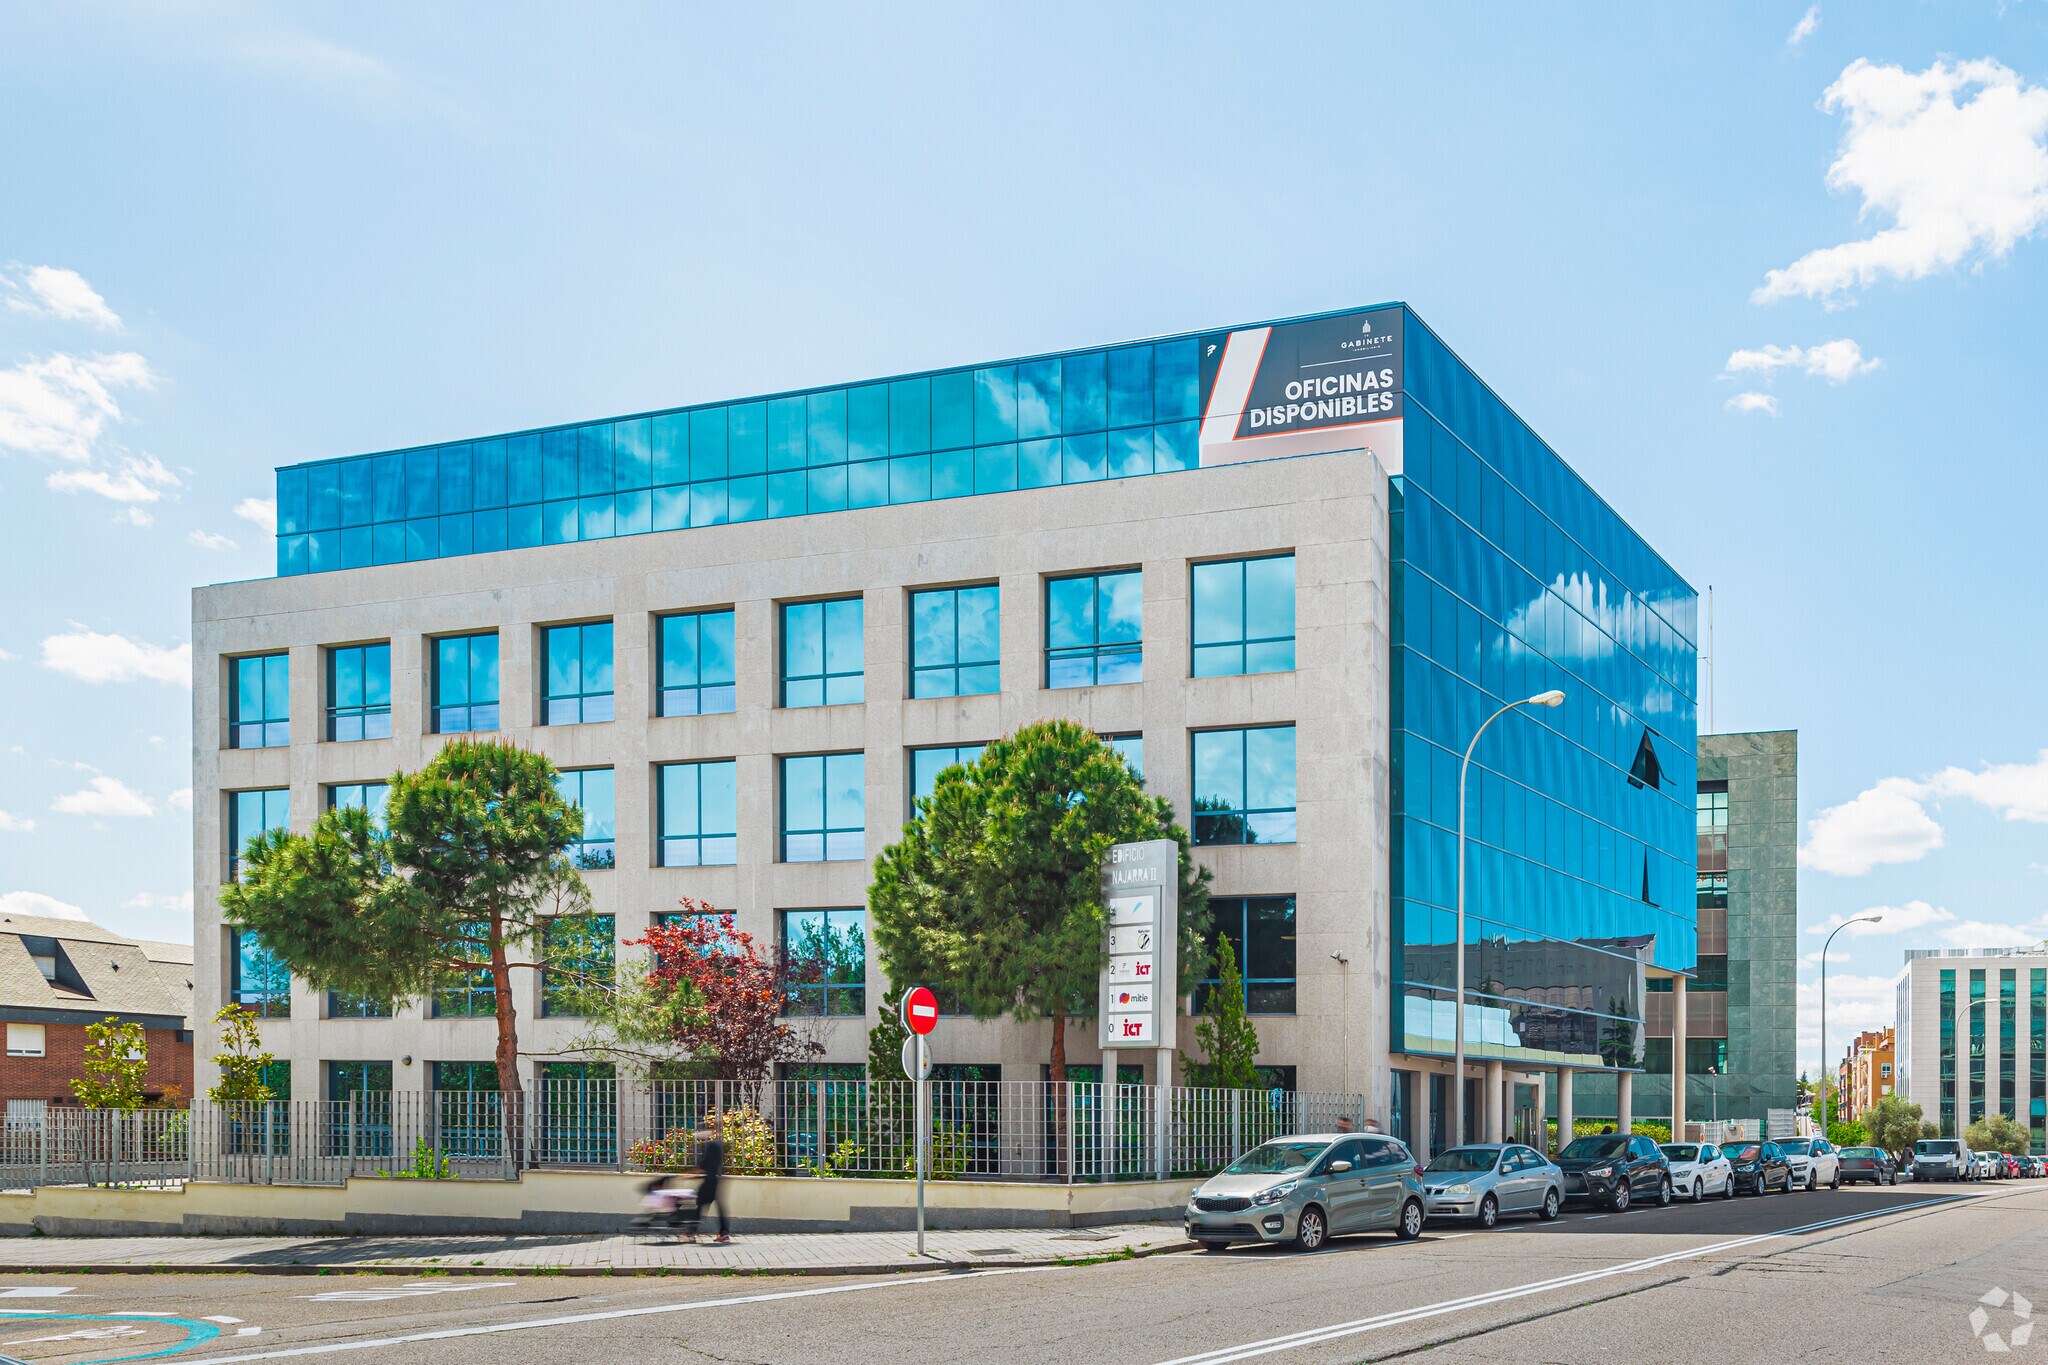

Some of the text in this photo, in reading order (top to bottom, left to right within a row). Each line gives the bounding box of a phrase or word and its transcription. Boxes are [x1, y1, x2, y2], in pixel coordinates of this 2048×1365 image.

[1340, 335, 1393, 349] GABINETE
[1285, 368, 1394, 400] OFICINAS
[1250, 391, 1394, 428] DISPONIBLES
[1112, 846, 1145, 864] EDIFICIO
[1112, 868, 1149, 885] NAJARRA
[1110, 935, 1116, 946] 3
[1110, 965, 1116, 975] 2
[1130, 993, 1148, 1002] mitie
[1108, 1023, 1114, 1033] 0
